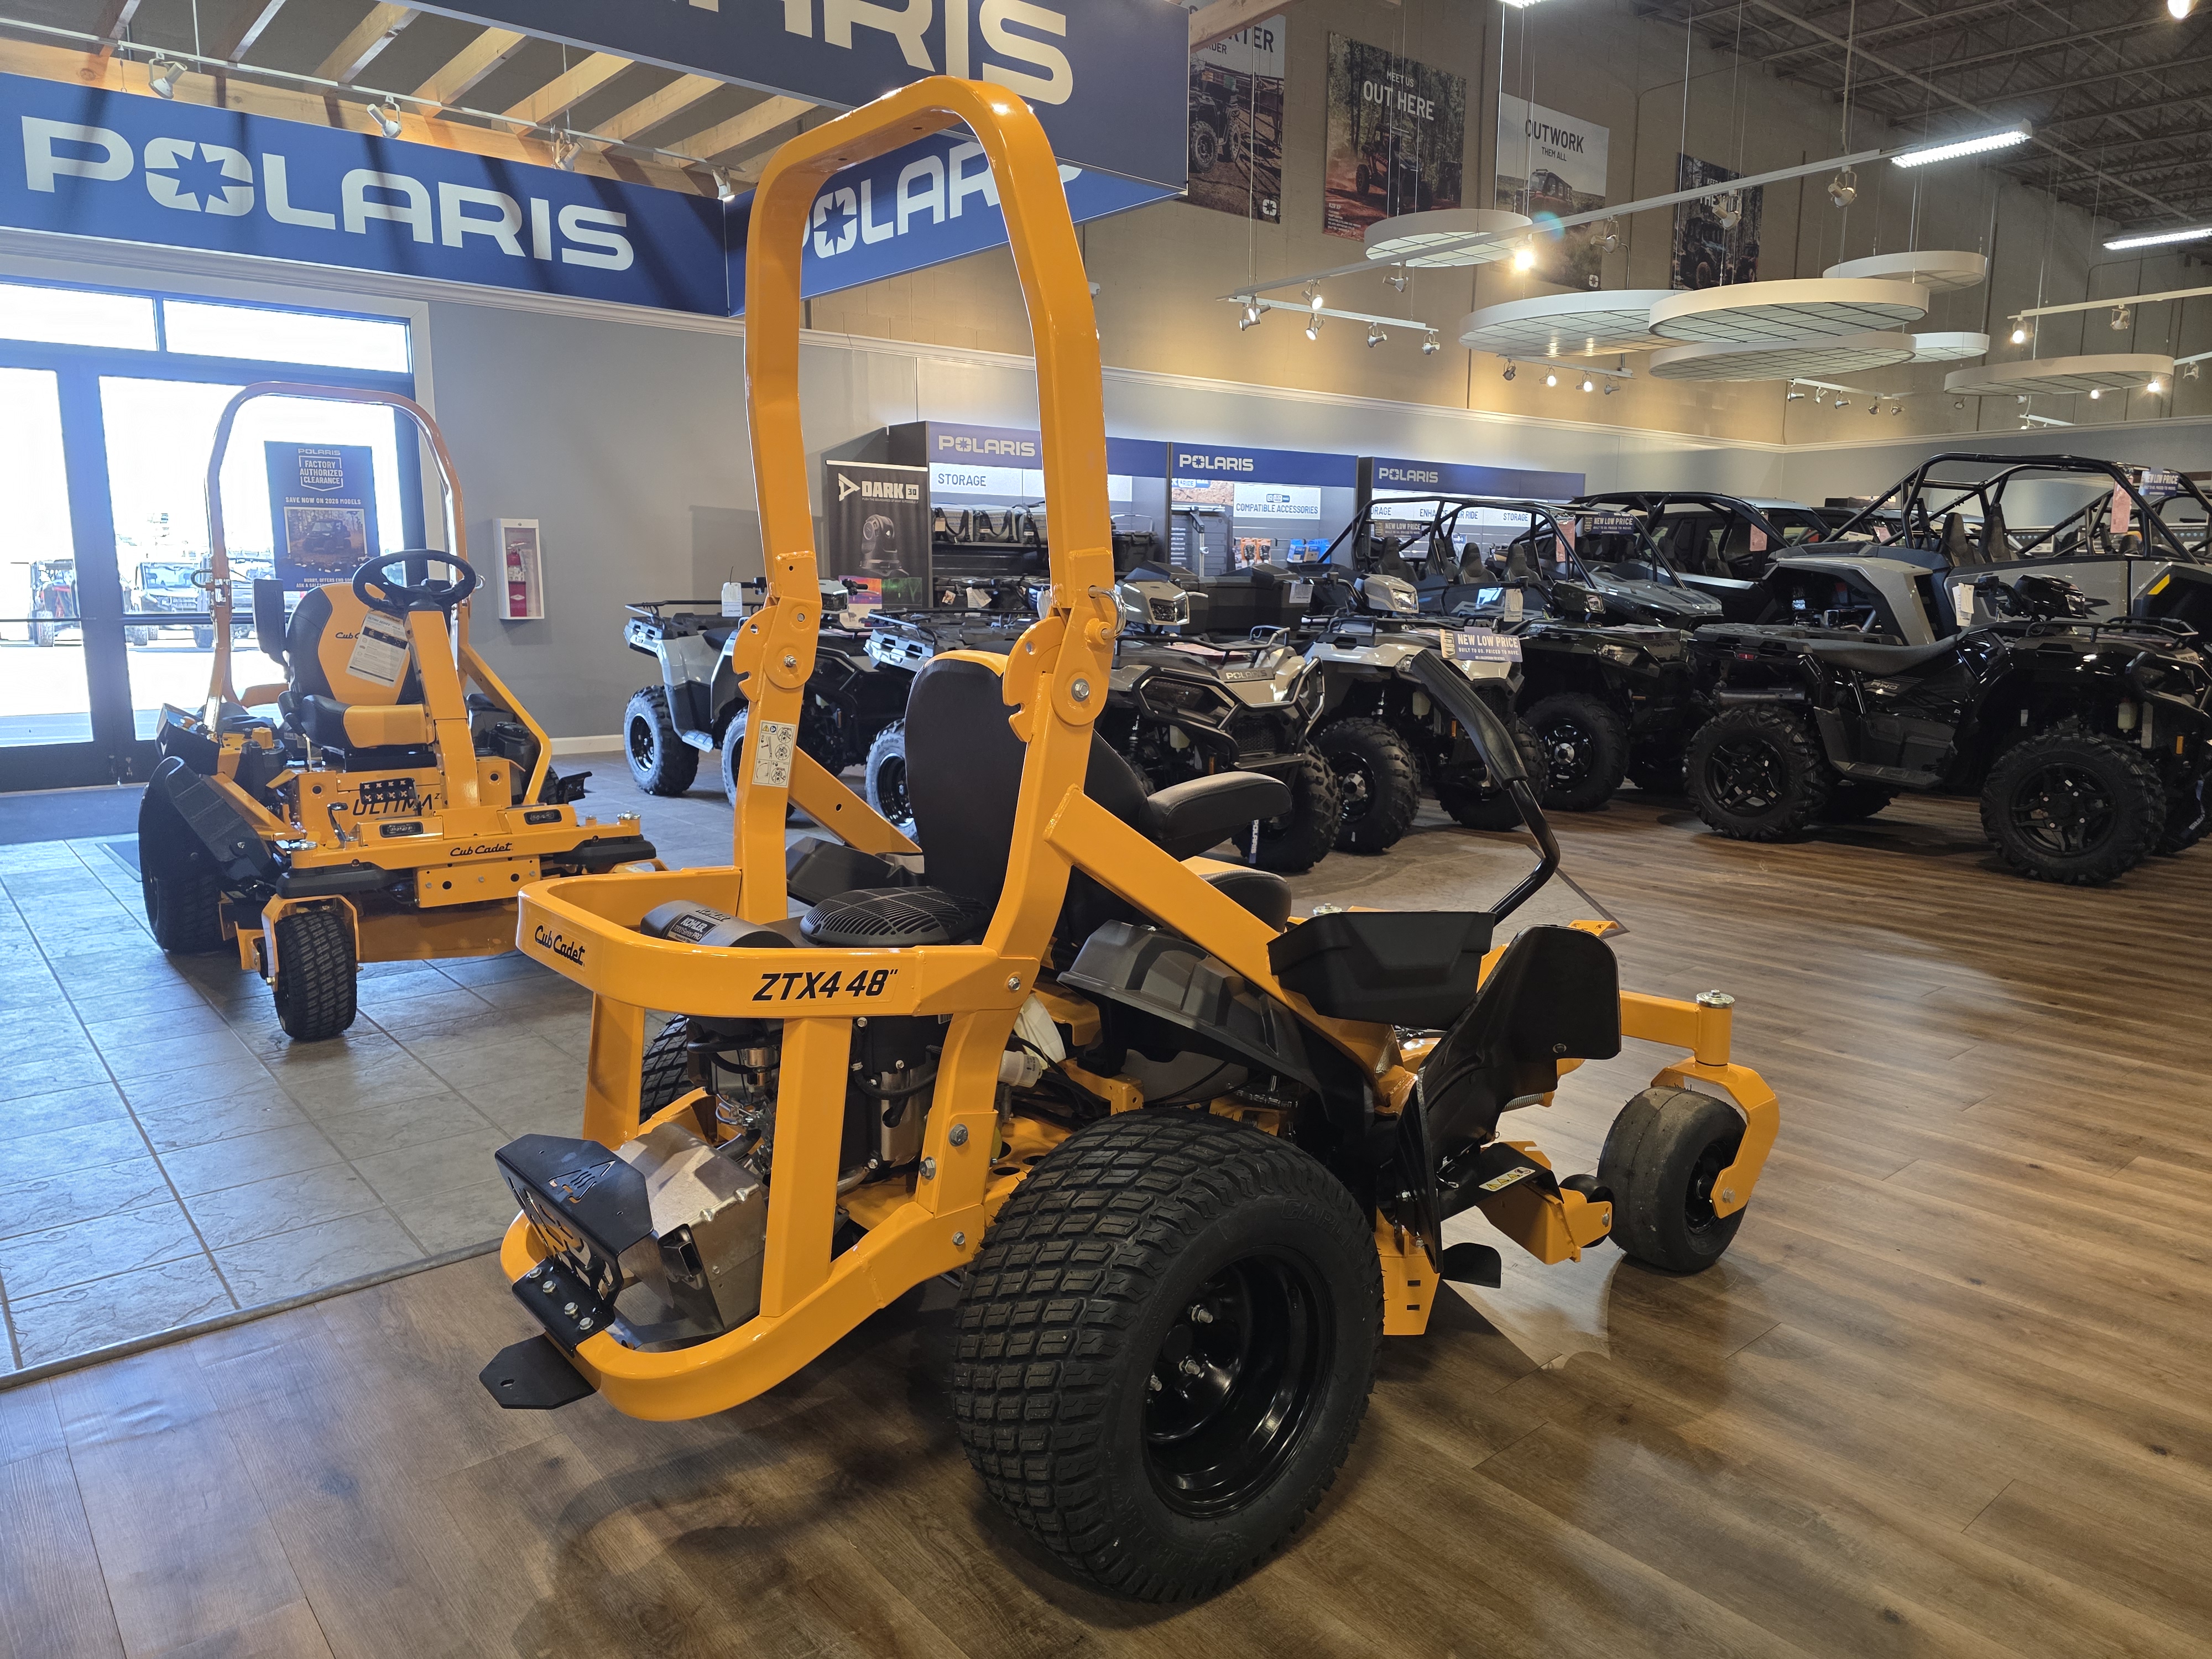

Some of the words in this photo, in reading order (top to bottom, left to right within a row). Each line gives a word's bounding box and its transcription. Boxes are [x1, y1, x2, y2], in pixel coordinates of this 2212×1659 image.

[1386, 70, 1405, 84] MEET
[1405, 76, 1415, 87] US
[1363, 80, 1394, 106] OUT
[1397, 90, 1435, 121] HERE
[1525, 119, 1584, 154] OUTWORK
[1541, 146, 1556, 158] THEM
[1557, 151, 1567, 161] ALL
[21, 116, 635, 271] POLARIS
[938, 435, 1036, 457] POLARIS
[305, 460, 336, 469] FACTORY
[1179, 454, 1254, 471] POLARIS
[300, 468, 343, 477] AUTHORIZED
[304, 476, 341, 484] CLEARANCE
[937, 473, 987, 487] STORAGE
[1379, 467, 1438, 483] POLARIS
[2163, 474, 2179, 484] PRICE
[862, 481, 904, 499] DARK
[1236, 503, 1275, 513] COMPATIBLE
[1276, 504, 1318, 514] ACCESSORIES
[1465, 510, 1479, 519] RIDE
[1503, 512, 1528, 521] STORAGE
[1457, 633, 1475, 646] NEW
[1477, 635, 1494, 646] LOW
[1495, 636, 1519, 648] PRICE
[1225, 670, 1267, 680] POLARIS
[1870, 681, 1898, 690] AWD
[450, 847, 473, 857] Cub
[474, 842, 513, 854] Cadet
[680, 917, 708, 933] KOHLER
[673, 925, 683, 933] 7000
[681, 928, 692, 938] Series
[691, 932, 702, 941] PRO
[534, 925, 552, 949] Cub
[553, 934, 586, 966] Cadet
[752, 971, 842, 1001] ZTX4
[845, 969, 899, 997] 48"
